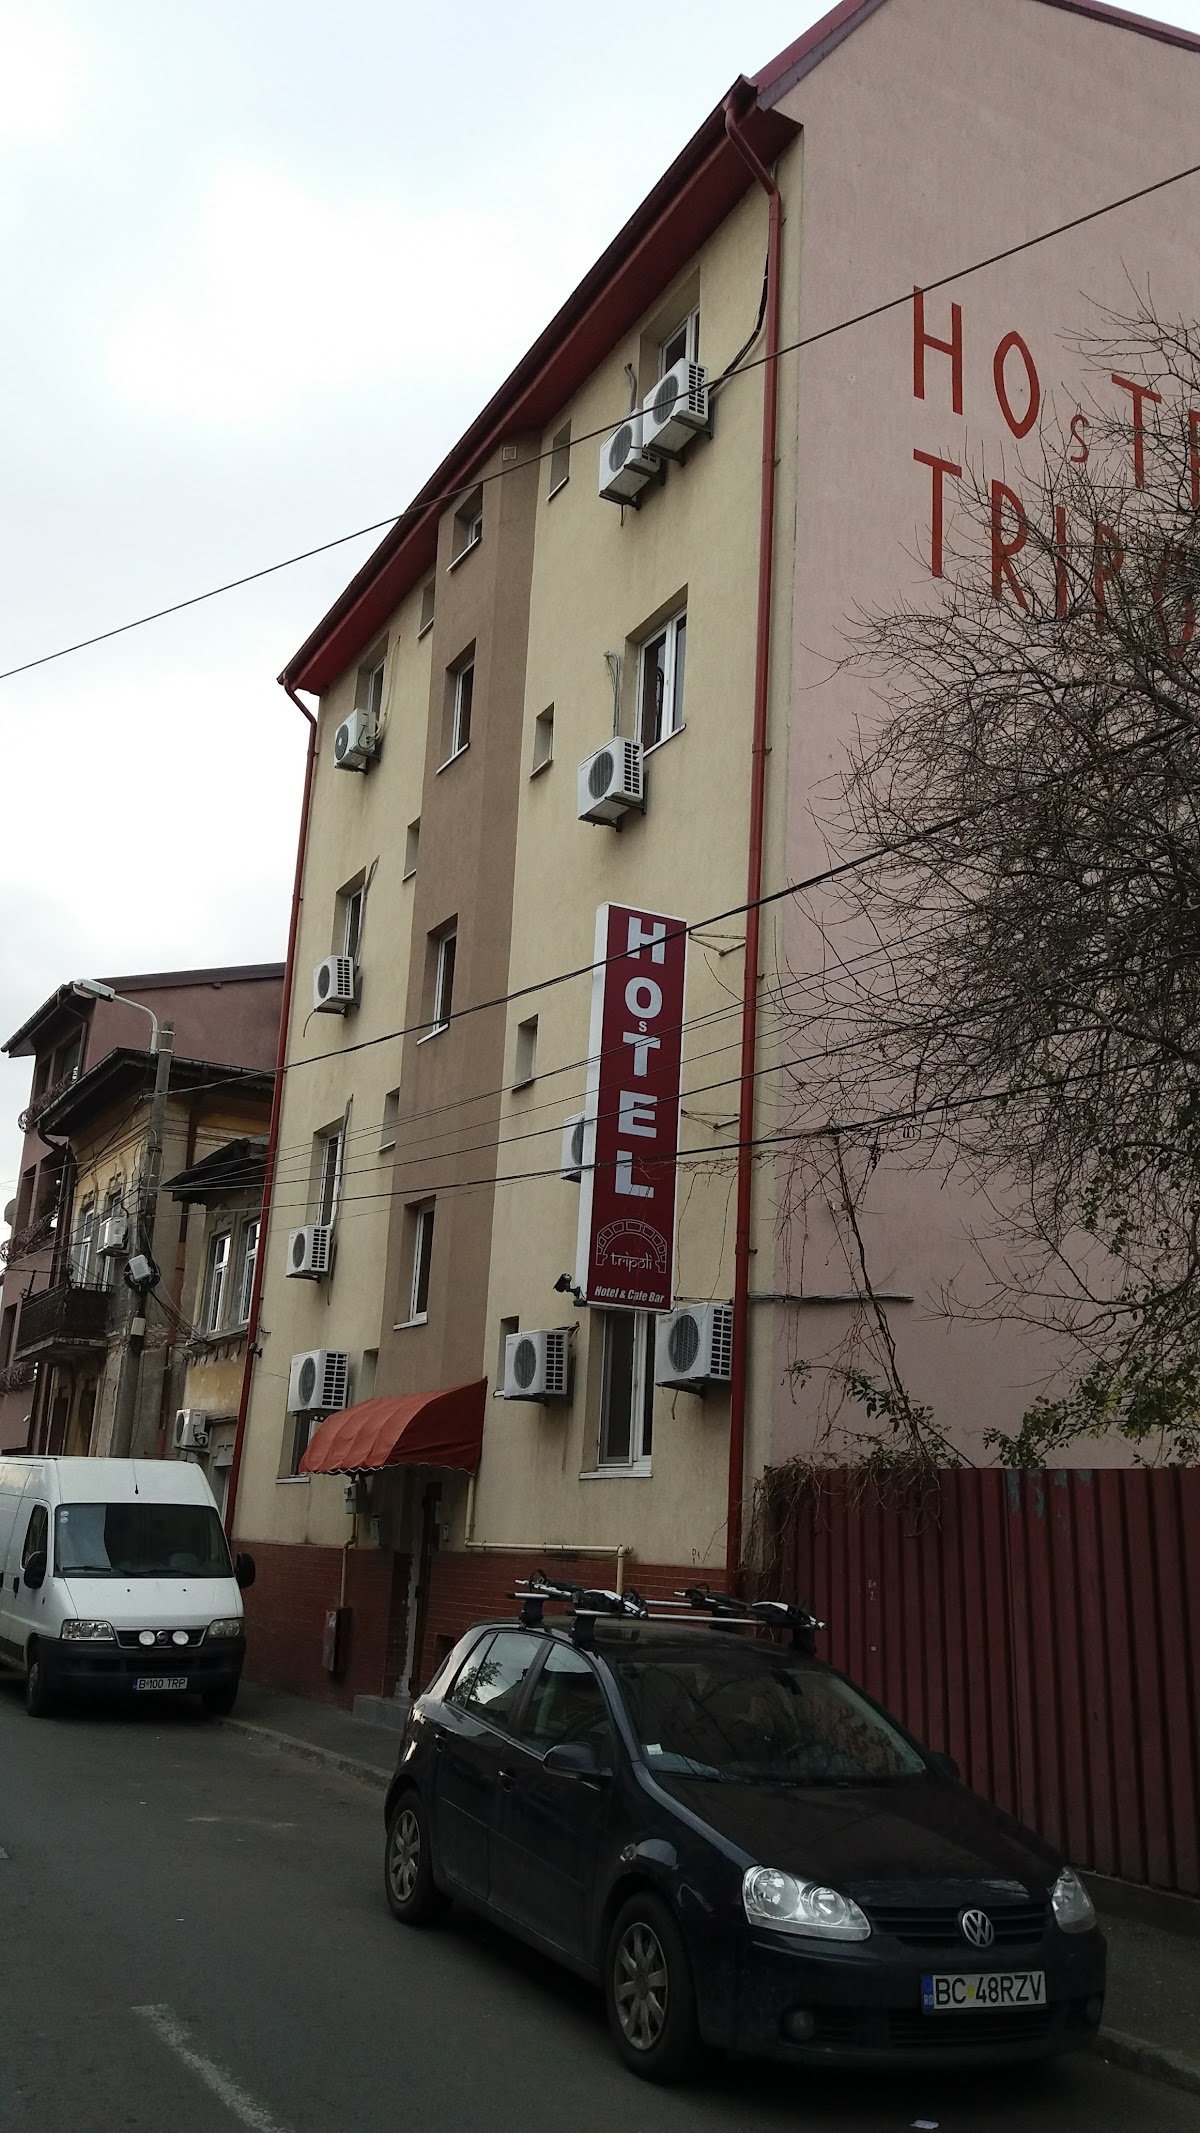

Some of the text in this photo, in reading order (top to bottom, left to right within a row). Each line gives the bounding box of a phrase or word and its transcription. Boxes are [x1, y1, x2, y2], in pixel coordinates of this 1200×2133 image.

[611, 1251, 653, 1273] tripoli
[594, 1285, 665, 1304] Hotel & Cafe Bar
[149, 1679, 164, 1689] 100
[167, 1678, 186, 1689] TRP
[935, 1974, 1042, 2005] BC 48RZV
